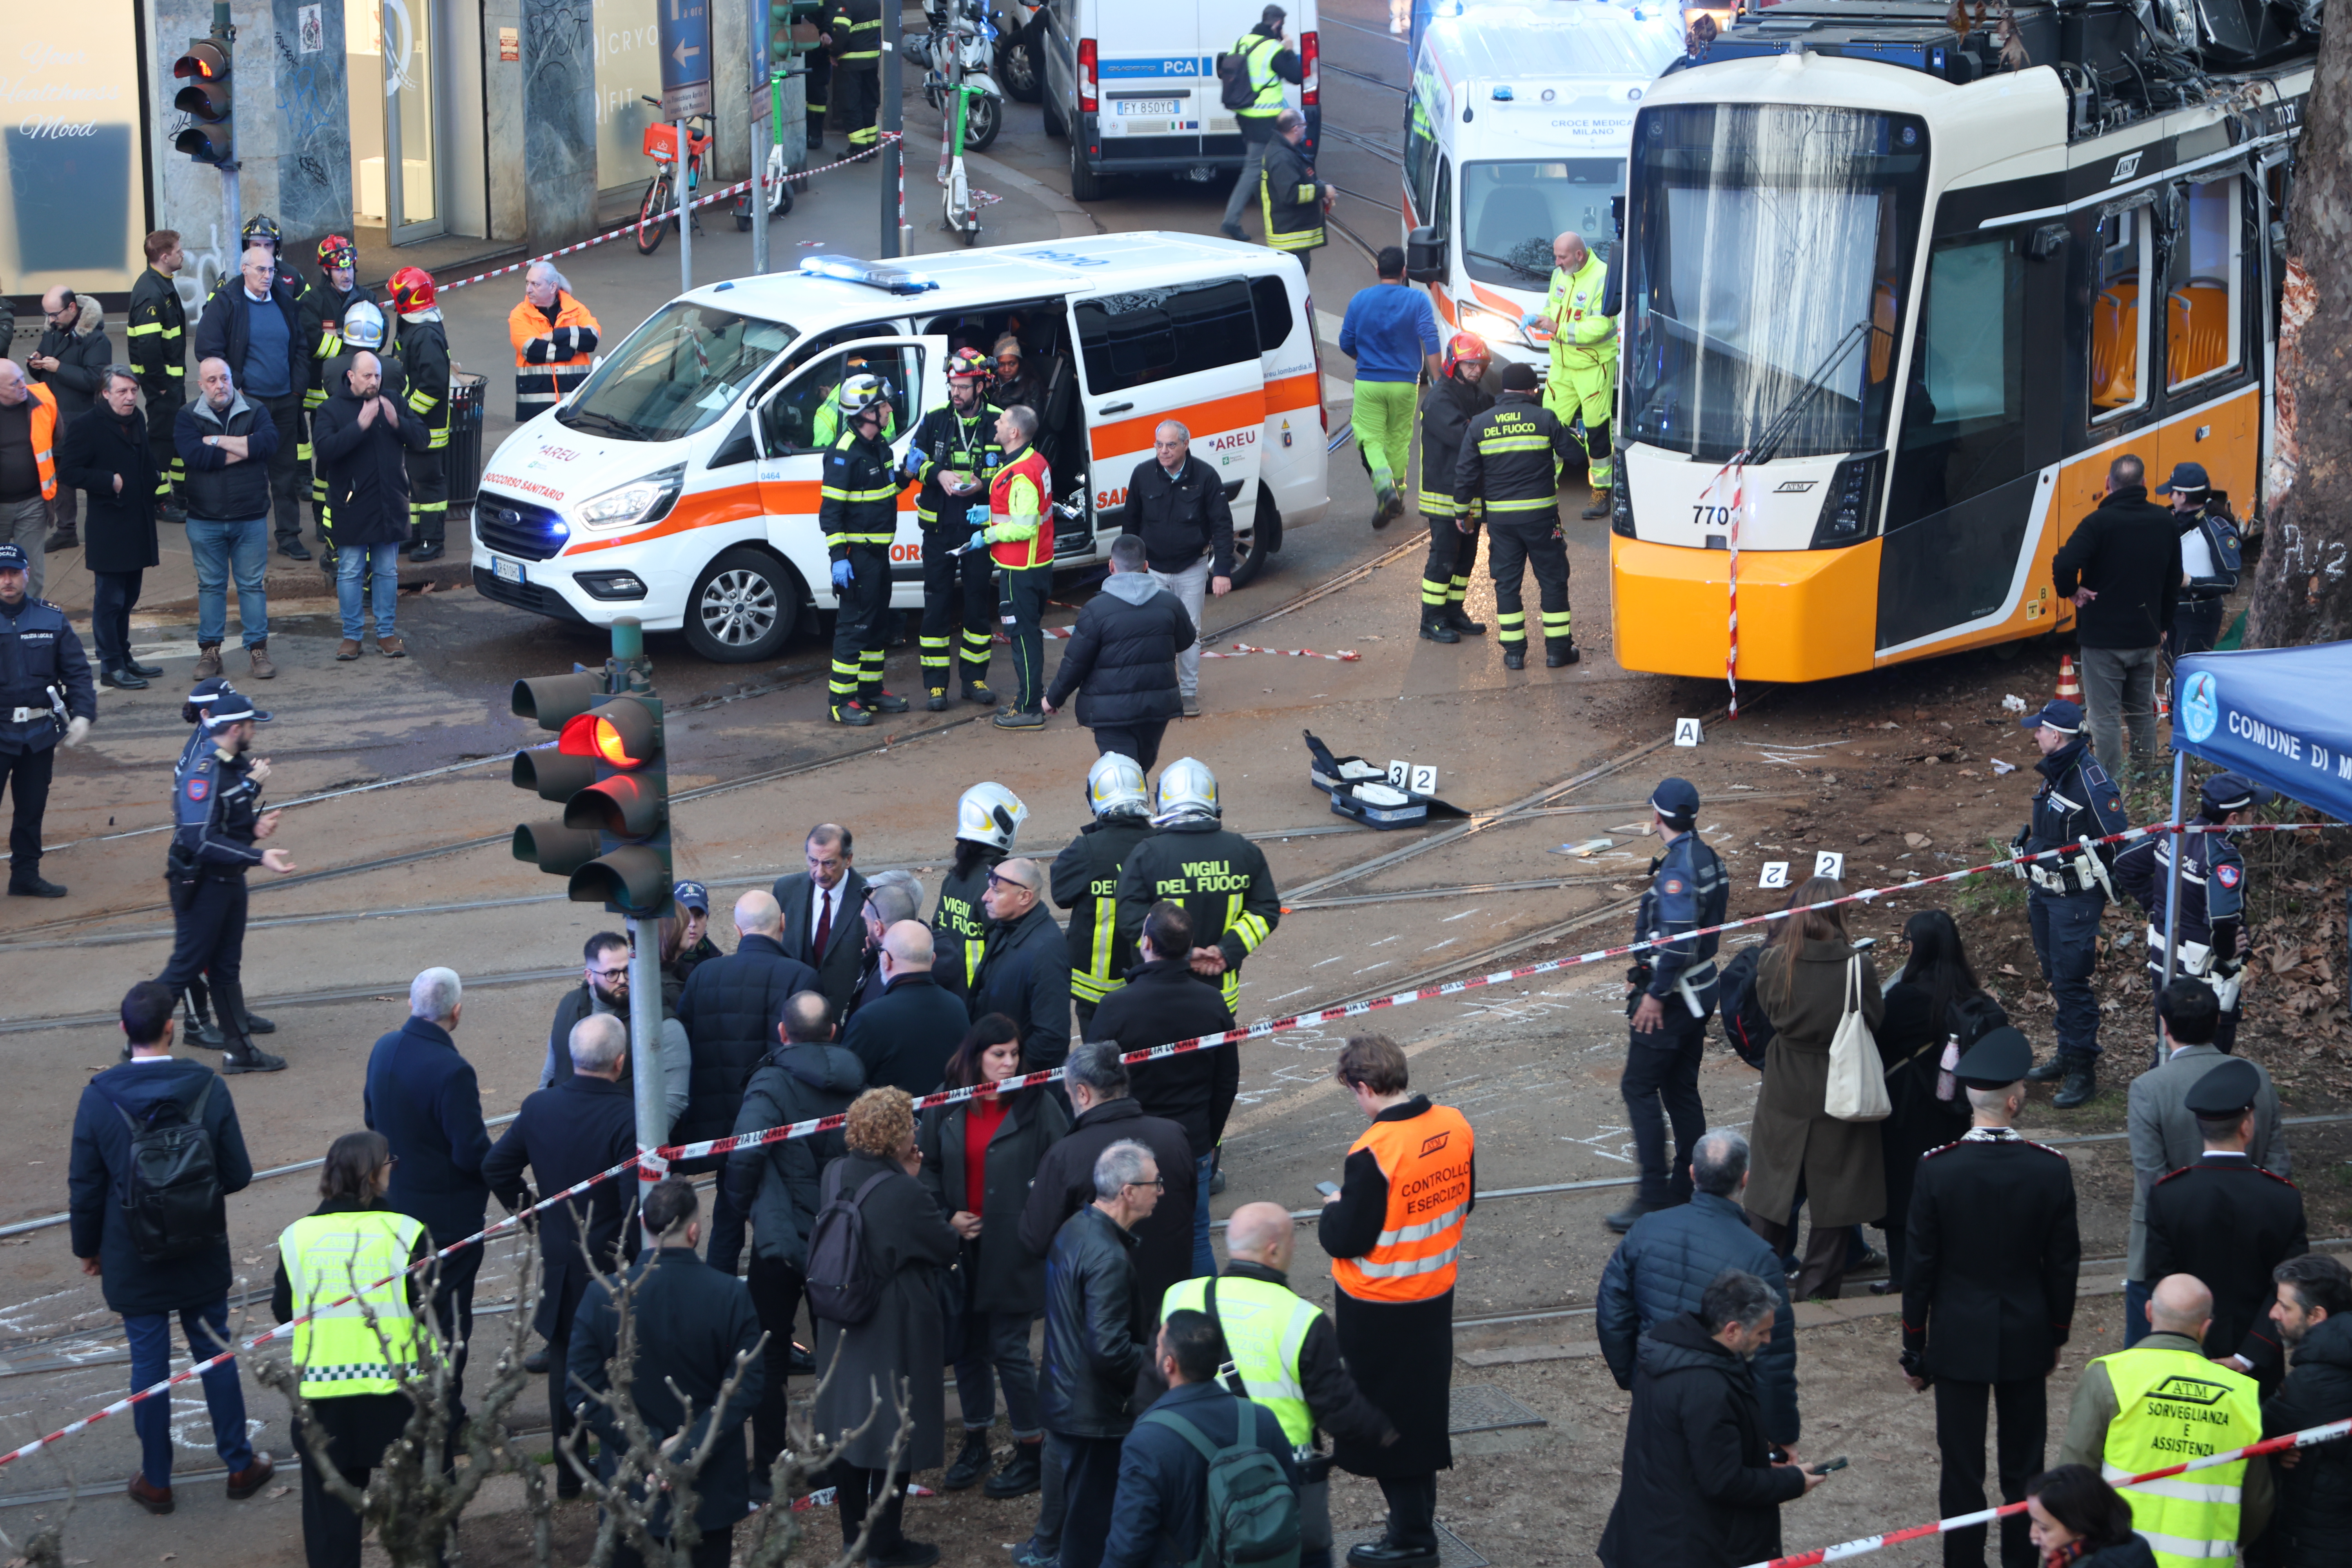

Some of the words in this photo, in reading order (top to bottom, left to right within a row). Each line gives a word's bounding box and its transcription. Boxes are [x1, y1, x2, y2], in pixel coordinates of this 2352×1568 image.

[690, 6, 703, 16] ore
[609, 25, 659, 54] CRYO
[20, 40, 89, 73] Your
[1164, 61, 1195, 74] PCA
[610, 88, 633, 112] FIT
[1124, 103, 1136, 113] FY
[1140, 102, 1173, 113] 850YC
[20, 114, 98, 139] Mood
[1495, 412, 1521, 423] VIGILI
[1483, 426, 1501, 437] DEL
[1502, 423, 1536, 435] FUOCO
[1216, 430, 1255, 451] AREU
[538, 446, 581, 461] AREU
[761, 472, 780, 480] 0464
[483, 472, 522, 488] SOCCORSO
[521, 481, 564, 501] SANITARIO
[2041, 588, 2046, 599] B
[1679, 722, 1693, 740] A
[2229, 710, 2301, 761] COMUNE
[2310, 744, 2328, 771] DI
[1391, 766, 1403, 786] 3
[1417, 770, 1430, 788] 2
[1181, 860, 1230, 877] VIGILI
[1767, 867, 1782, 883] 2
[1820, 856, 1835, 876] 2
[1156, 879, 1191, 895] DEL
[1197, 875, 1250, 892] FUOCO
[1225, 1024, 1262, 1039] POLIZIA
[1263, 1016, 1297, 1031] LOCALE
[1126, 1045, 1163, 1060] POLIZIA
[1165, 1038, 1200, 1051] LOCALE
[712, 1134, 750, 1151] POLIZIA
[752, 1125, 792, 1143] LOCALE
[1402, 1161, 1470, 1198] CONTROLLO
[1407, 1182, 1465, 1214] ESERCIZIO
[2147, 1402, 2229, 1426] SORVEGLIANZA
[2183, 1423, 2190, 1436] E
[2151, 1436, 2214, 1457] ASSISTENZA
